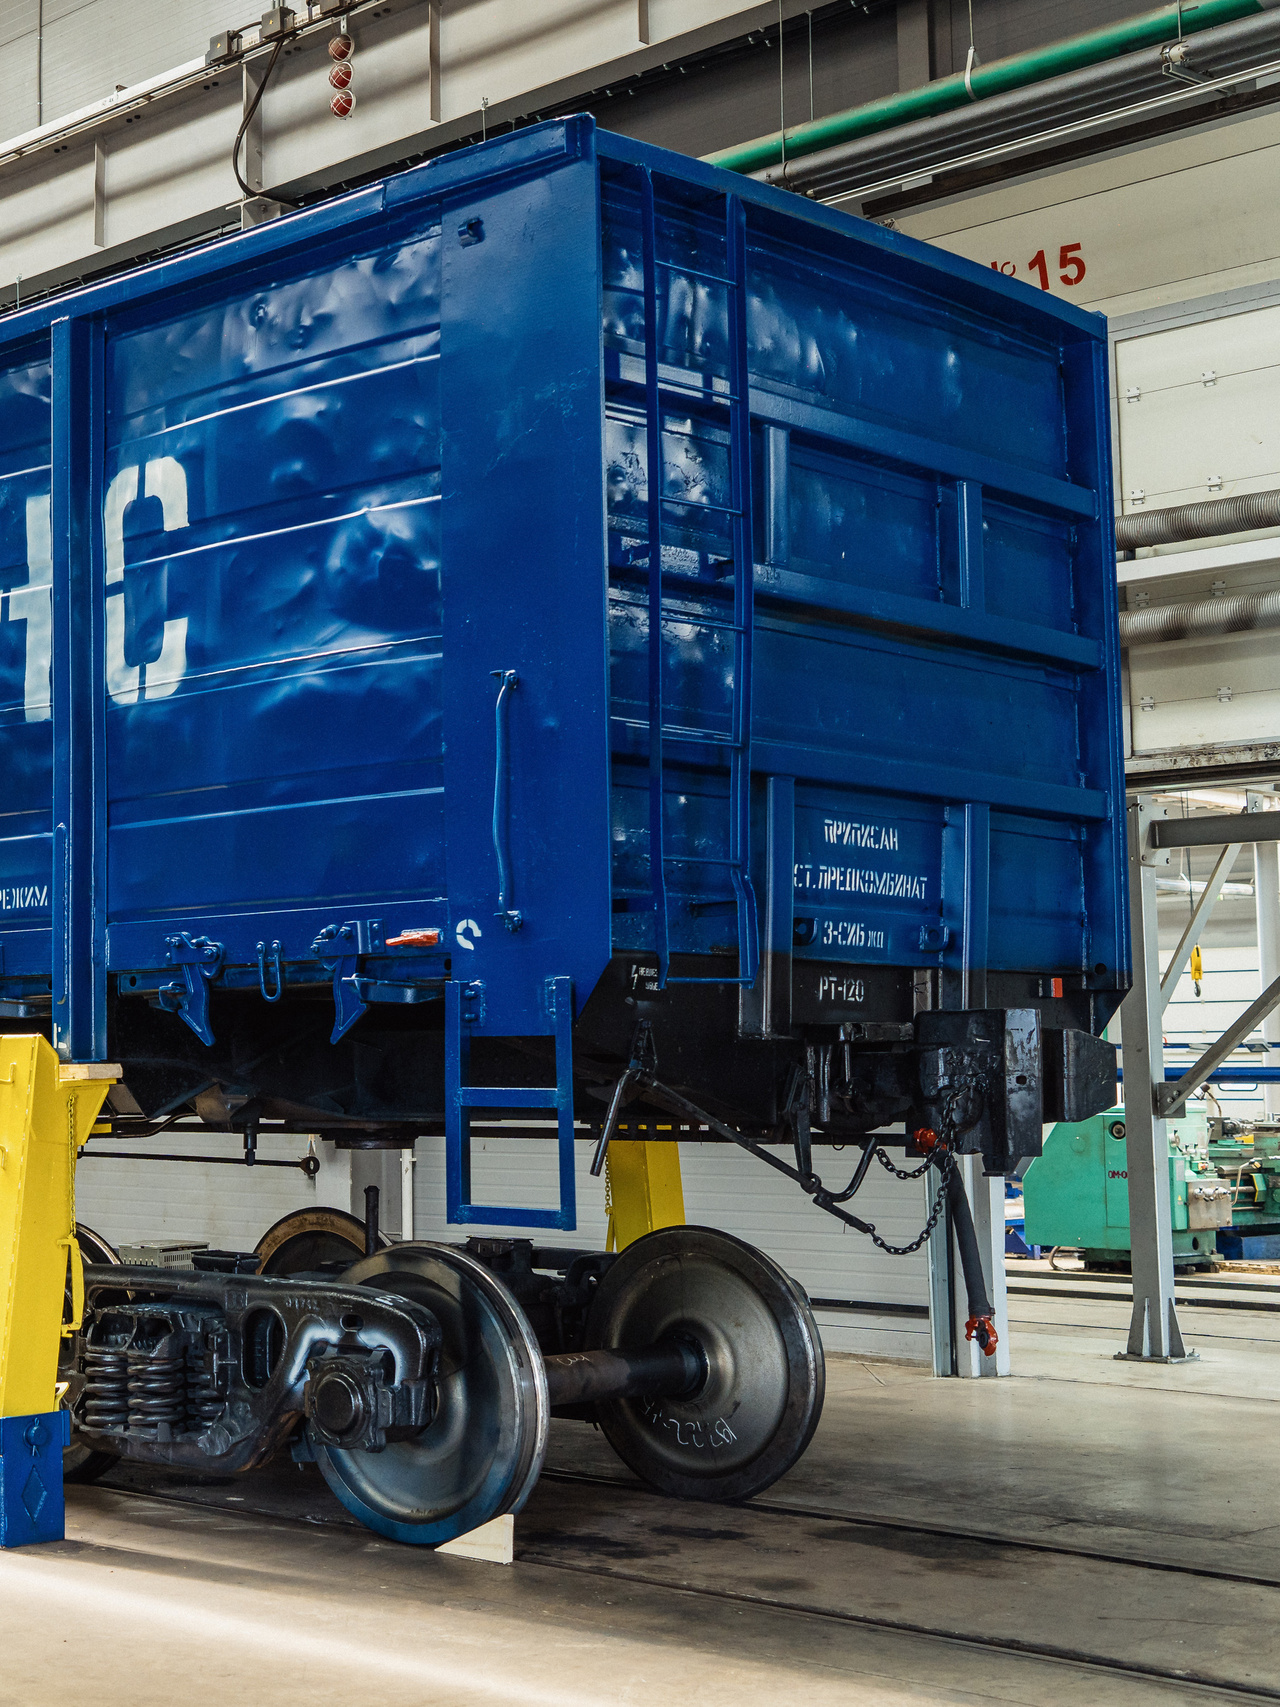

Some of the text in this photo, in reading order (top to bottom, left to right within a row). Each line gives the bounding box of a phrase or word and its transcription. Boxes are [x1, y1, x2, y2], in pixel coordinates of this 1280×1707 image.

[1028, 242, 1086, 291] 15
[824, 819, 899, 851] ПРИПИСАН
[820, 975, 865, 1003] РТ-120
